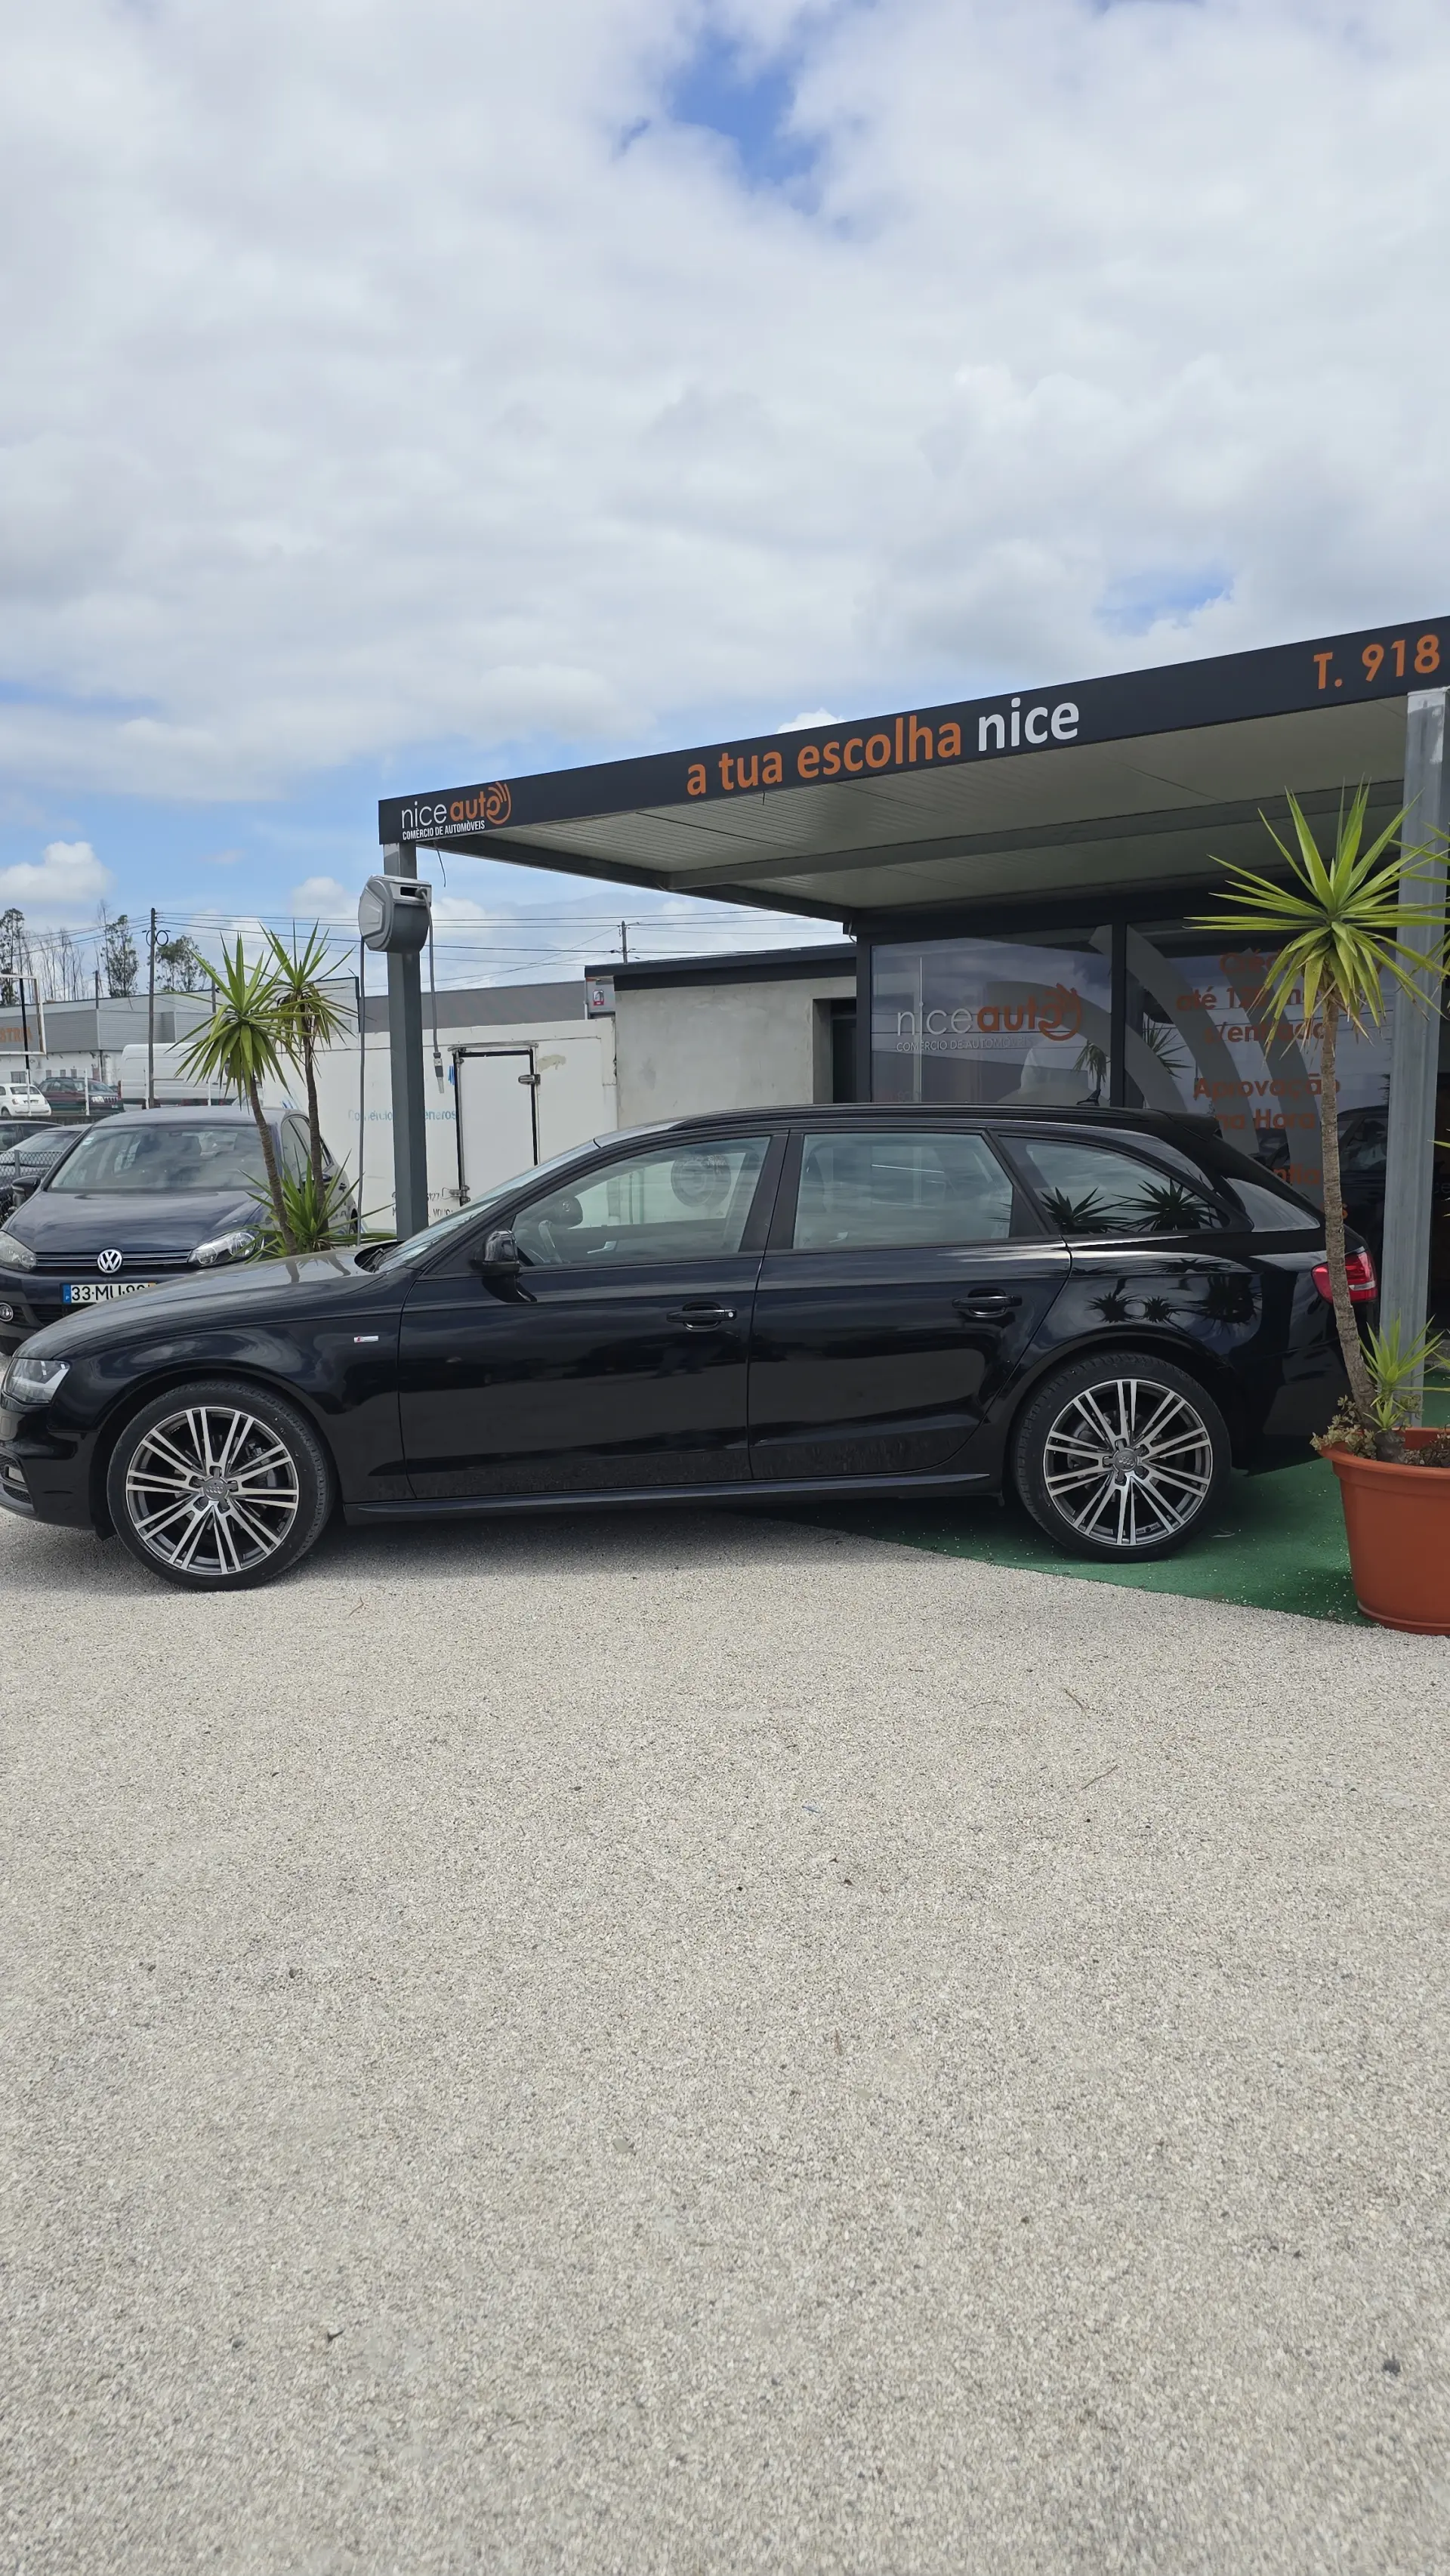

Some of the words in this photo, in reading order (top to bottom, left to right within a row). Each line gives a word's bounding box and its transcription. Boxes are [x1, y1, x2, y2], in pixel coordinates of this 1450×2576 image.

[1313, 652, 1343, 690] T.
[1362, 634, 1440, 682] 918
[686, 763, 707, 796] a
[719, 752, 782, 790] tua
[798, 715, 962, 779] escolha
[979, 697, 1079, 752] nice
[435, 826, 444, 836] DE
[1254, 1108, 1316, 1130] Hora
